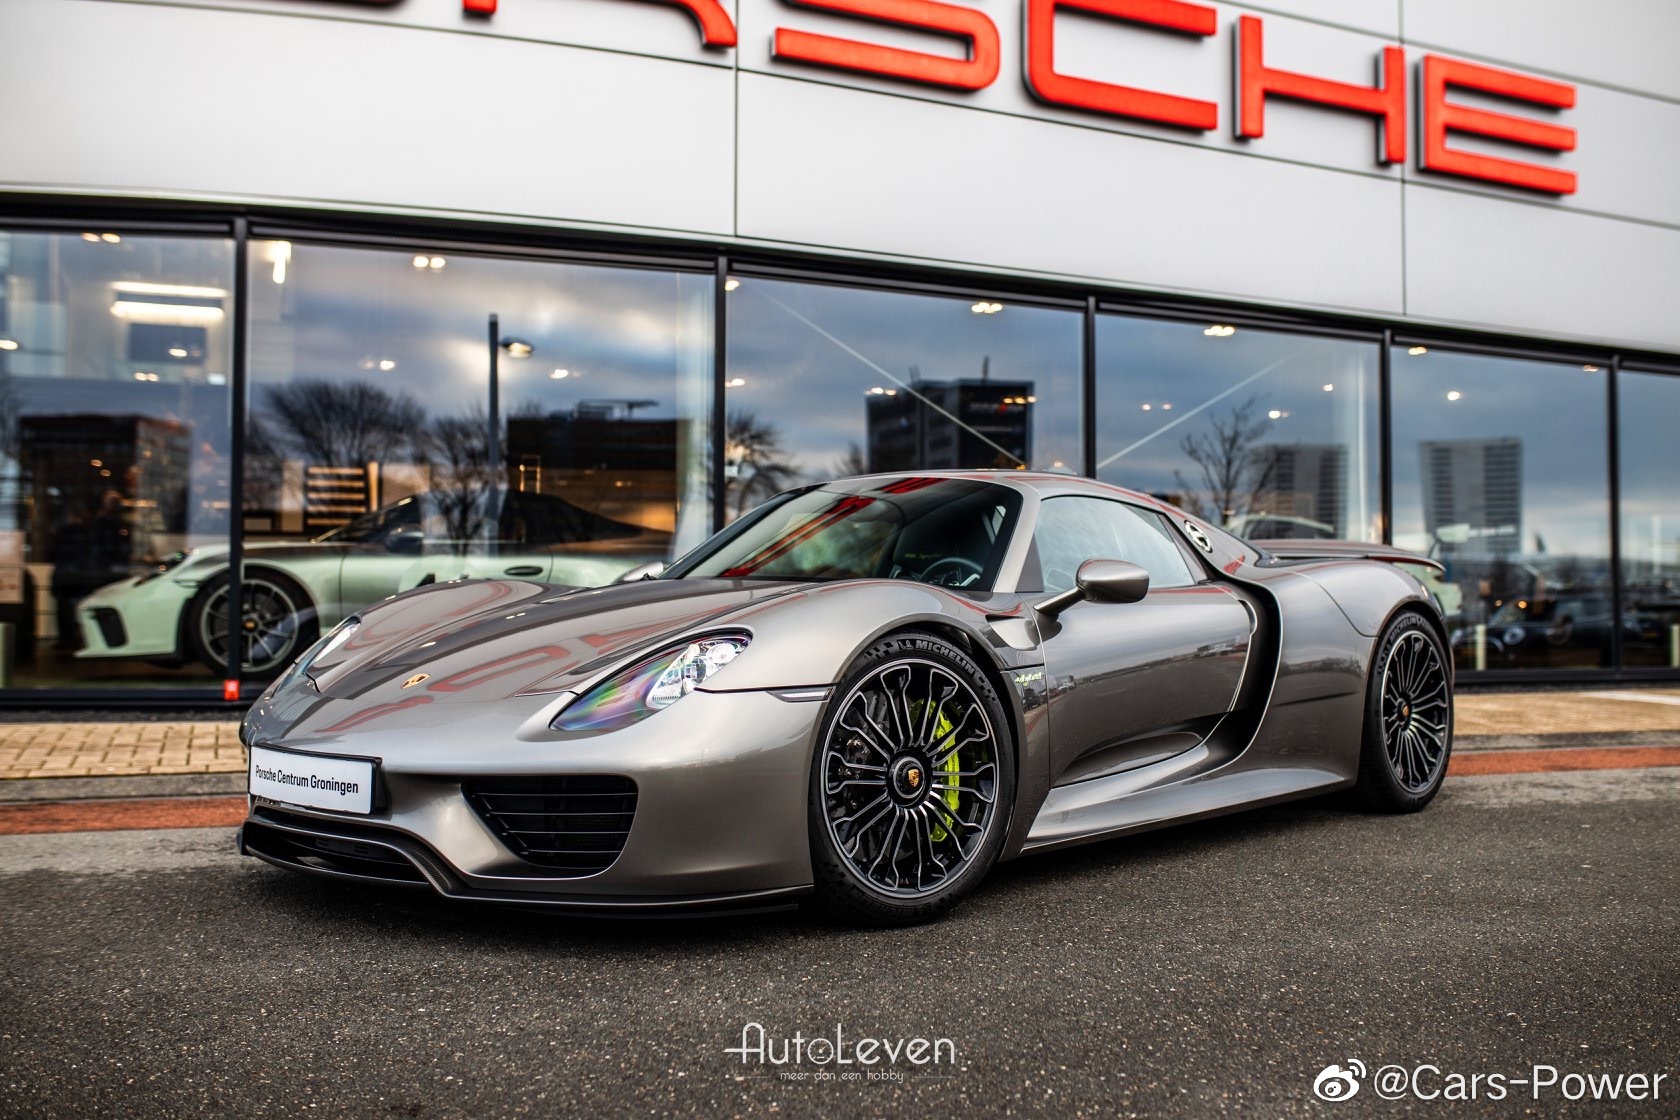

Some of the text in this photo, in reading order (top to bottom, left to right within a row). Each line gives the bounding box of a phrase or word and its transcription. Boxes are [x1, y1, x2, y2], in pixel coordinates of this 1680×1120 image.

[290, 0, 1578, 196] SCHE
[915, 639, 976, 676] MICHELIN
[255, 764, 359, 796] Porsche Centrum Groningen
